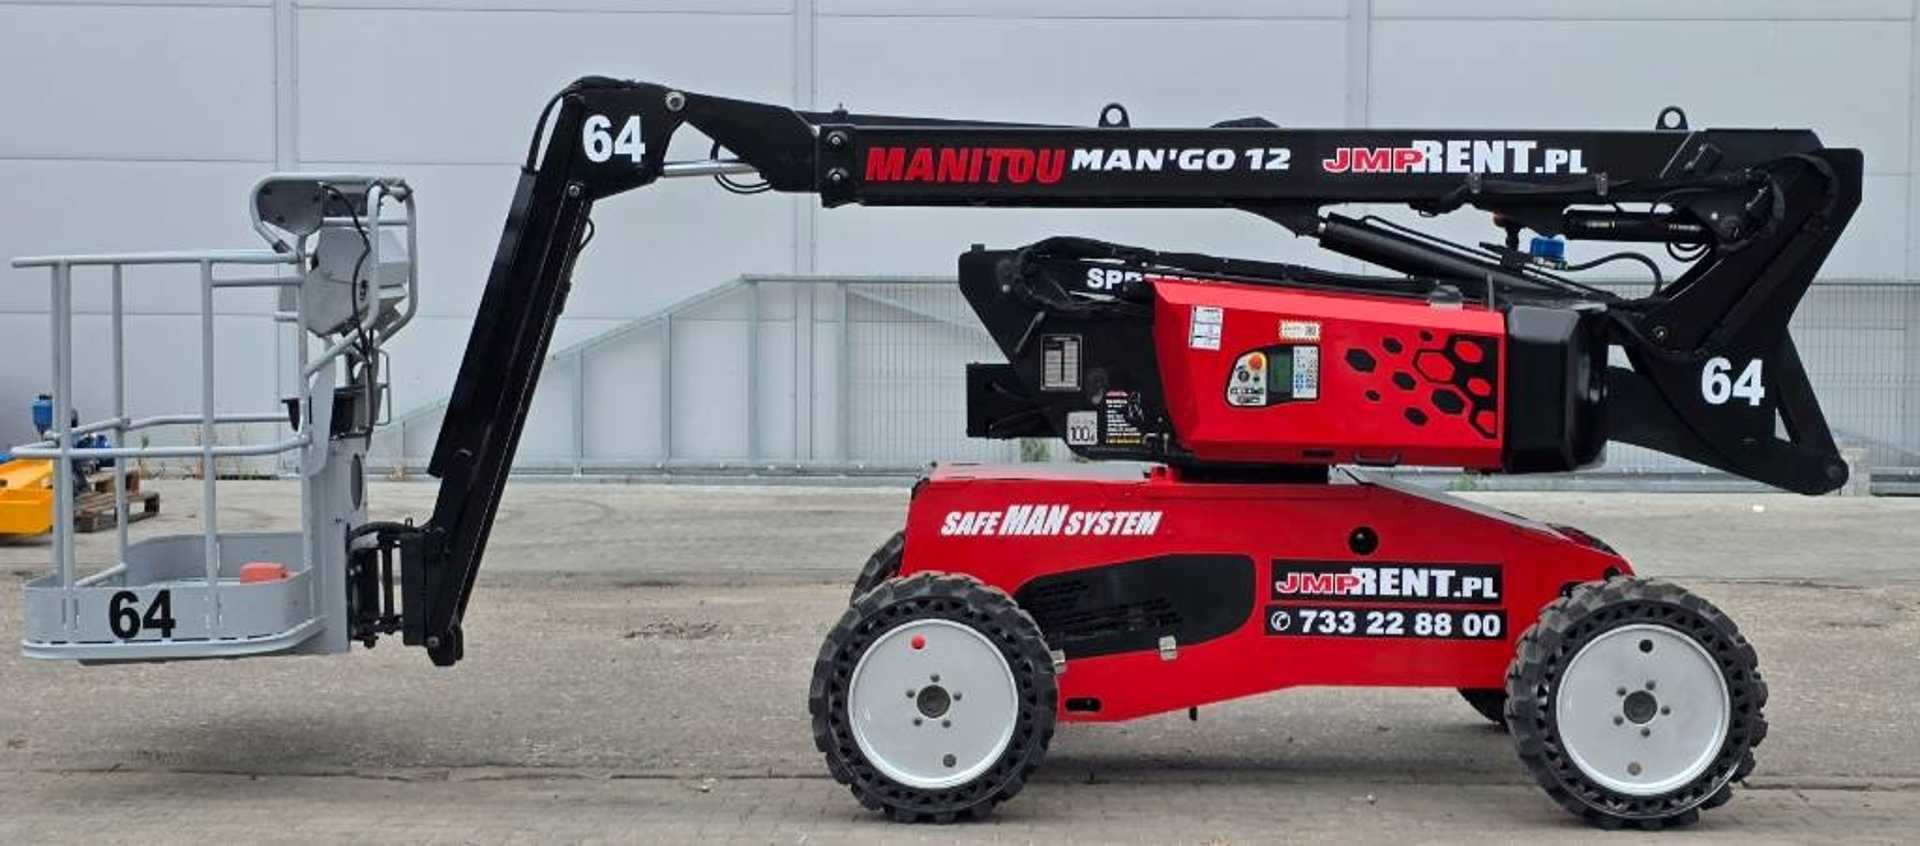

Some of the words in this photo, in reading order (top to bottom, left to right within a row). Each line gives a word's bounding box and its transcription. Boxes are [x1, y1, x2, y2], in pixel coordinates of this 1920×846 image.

[583, 115, 645, 162] 64
[865, 146, 1066, 184] MANITOU
[1071, 148, 1236, 171] MAN'GO
[1245, 148, 1291, 171] 12
[1702, 357, 1764, 405] 64
[941, 511, 1002, 535] SAFE
[1000, 504, 1070, 535] MAN
[1064, 511, 1163, 535] SYSTEM
[110, 590, 176, 640] 64
[1299, 610, 1356, 634] 733
[1366, 611, 1405, 635] 22
[1414, 613, 1452, 637] 88
[1462, 613, 1501, 637] 00
